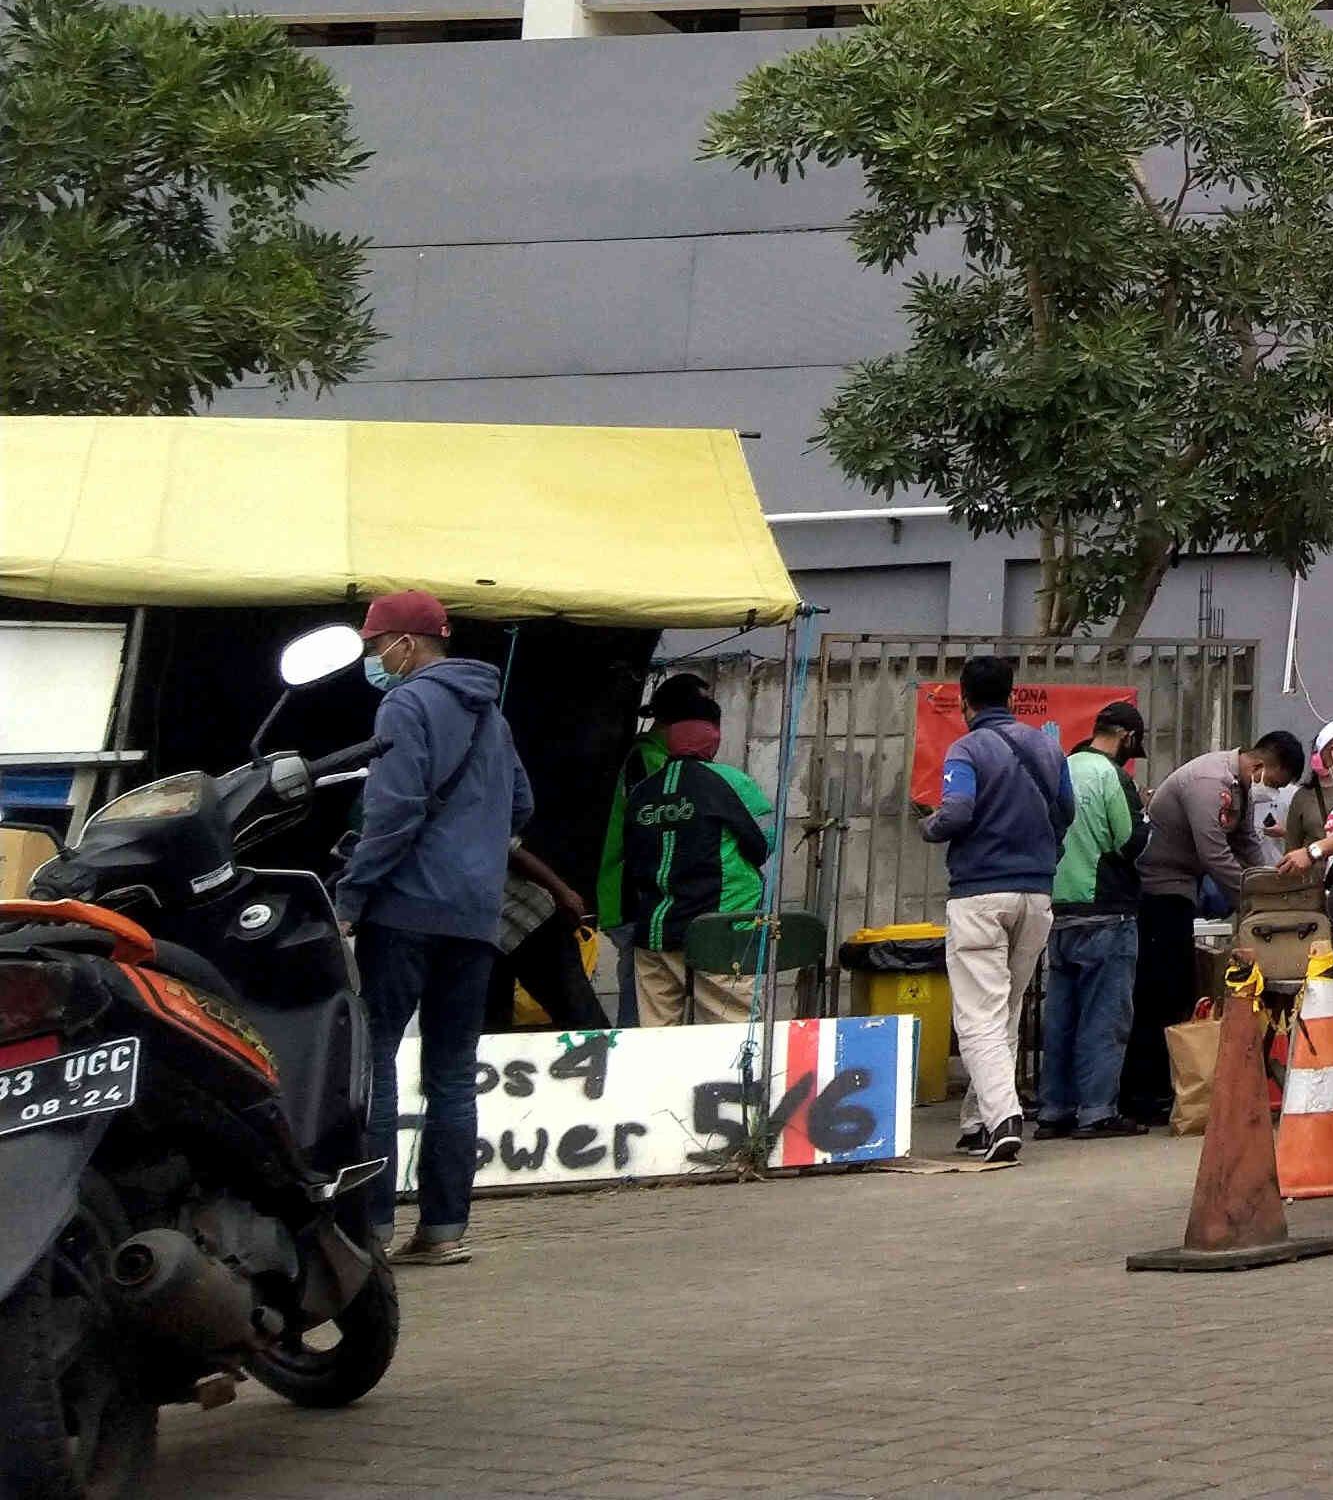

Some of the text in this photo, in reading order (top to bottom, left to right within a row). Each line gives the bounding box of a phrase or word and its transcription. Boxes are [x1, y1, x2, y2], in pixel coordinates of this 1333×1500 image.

[637, 796, 695, 826] Grab
[64, 1045, 131, 1083] UGC
[474, 1034, 609, 1100] os 4
[397, 1112, 647, 1172] ower
